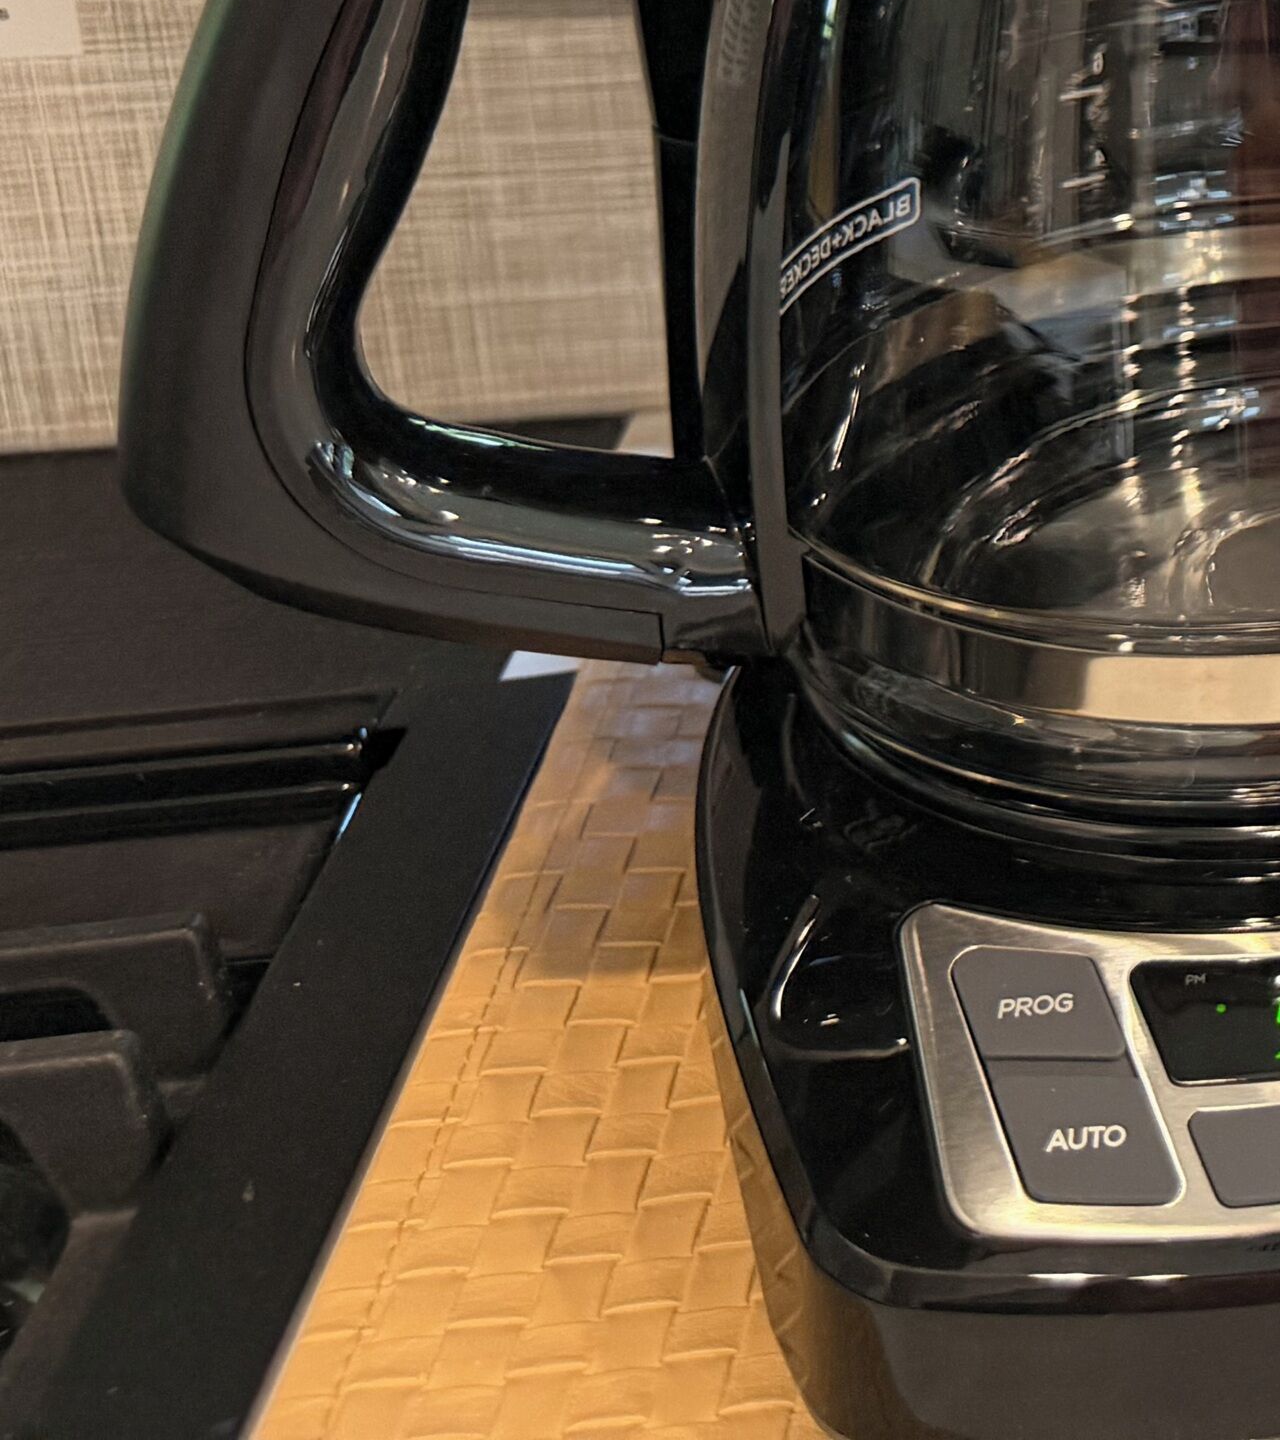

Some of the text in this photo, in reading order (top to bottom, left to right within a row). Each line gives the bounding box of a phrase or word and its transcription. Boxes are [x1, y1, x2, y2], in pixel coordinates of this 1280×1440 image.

[1185, 973, 1206, 986] PM
[997, 991, 1075, 1019] PROG
[1045, 1123, 1127, 1152] AUTO
